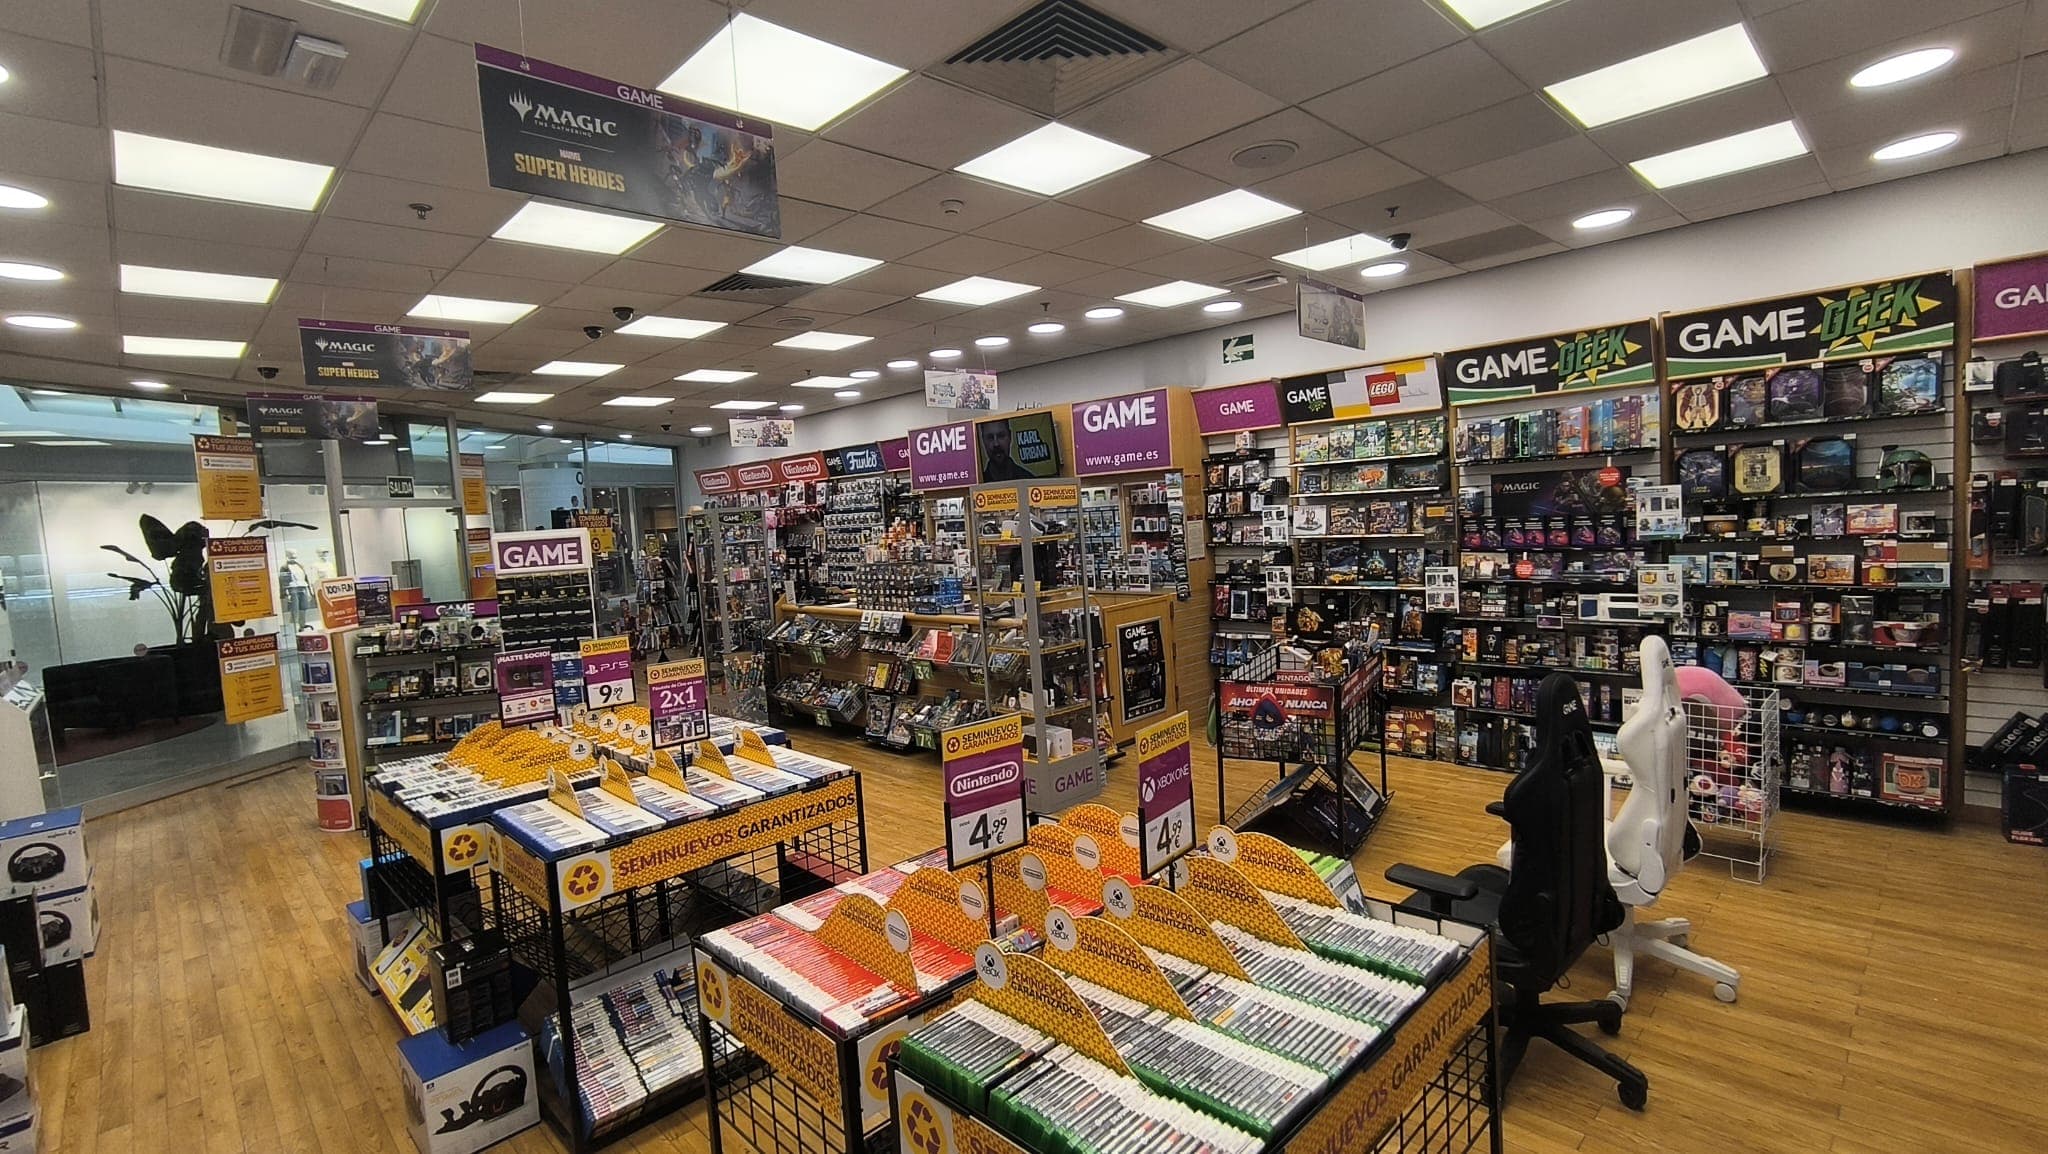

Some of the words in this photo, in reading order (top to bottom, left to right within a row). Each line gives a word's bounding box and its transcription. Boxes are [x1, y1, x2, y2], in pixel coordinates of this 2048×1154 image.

[616, 86, 664, 110] GAME
[534, 103, 618, 137] MAGIC
[514, 151, 568, 182] SUPER
[569, 161, 626, 193] HEROES
[1994, 282, 2048, 309] GA
[1820, 279, 1923, 342] GEEK
[374, 324, 401, 334] GAME
[1679, 307, 1806, 353] GAME
[328, 341, 376, 352] MAGIC
[1558, 327, 1628, 377] GEEK
[318, 366, 347, 378] SUPER
[347, 368, 380, 379] HEROES
[1456, 348, 1548, 384] GAME
[1286, 386, 1327, 404] GAME
[1368, 378, 1396, 398] LEGO
[268, 406, 304, 416] MAGIC
[1083, 396, 1156, 432] GAME
[1220, 400, 1256, 416] GAME
[916, 426, 967, 456] GAME
[1016, 430, 1040, 446] KARL
[826, 457, 842, 467] GAME
[846, 450, 878, 471] Funko
[899, 450, 911, 459] GA
[1019, 444, 1048, 462] URBAN
[1086, 451, 1159, 468] www.game.es
[740, 471, 770, 482] Nintendo
[784, 462, 818, 474] Nintendo
[918, 470, 969, 484] www.game.es
[702, 476, 729, 486] Nintendo
[1502, 482, 1540, 491] MAGIC
[503, 542, 579, 568] GAME
[1125, 625, 1147, 639] GAME
[524, 650, 550, 660] SOCIO!
[600, 660, 629, 672] PS5
[662, 663, 702, 674] SEMINUEVOS
[660, 686, 697, 708] 2x1
[1285, 699, 1328, 710] NUNCA
[1404, 710, 1424, 720] ATAN
[962, 722, 1018, 742] SEMINUEVOS
[962, 731, 1018, 751] GARANTIZADOS
[1149, 720, 1188, 744] SEMINUEVOS
[1150, 730, 1188, 752] GARANTIZADOS
[956, 768, 1014, 792] Nintendo
[1055, 767, 1094, 793] GAME
[1156, 770, 1176, 791] XBOX
[1174, 764, 1190, 782] ONE
[618, 830, 734, 877] SEMINUEVOS
[738, 792, 856, 840] GARANTIZADOS
[1241, 854, 1306, 876] GARANTIZADOS
[1242, 846, 1293, 865] SEMINUEVOS
[1192, 870, 1246, 892] SEMINUEVOS
[1192, 880, 1258, 906] GARANTIZADOS
[1108, 899, 1128, 910] XBOX
[1138, 900, 1193, 922] SEMINUEVOS
[1138, 910, 1208, 937] GARANTIZADOS
[1050, 930, 1070, 941] XBOX
[1080, 932, 1137, 958] SEMINUEVOS
[1081, 942, 1151, 975] GARANTIZADOS
[981, 966, 1000, 978] XBOX
[1011, 970, 1068, 1000] SEMINUEVOS
[1010, 982, 1083, 1019] GARANTIZADOS
[736, 990, 834, 1075] SEMINUEVOS
[1392, 966, 1491, 1090] GARANTIZADOS
[738, 1013, 836, 1098] GARANTIZADOS
